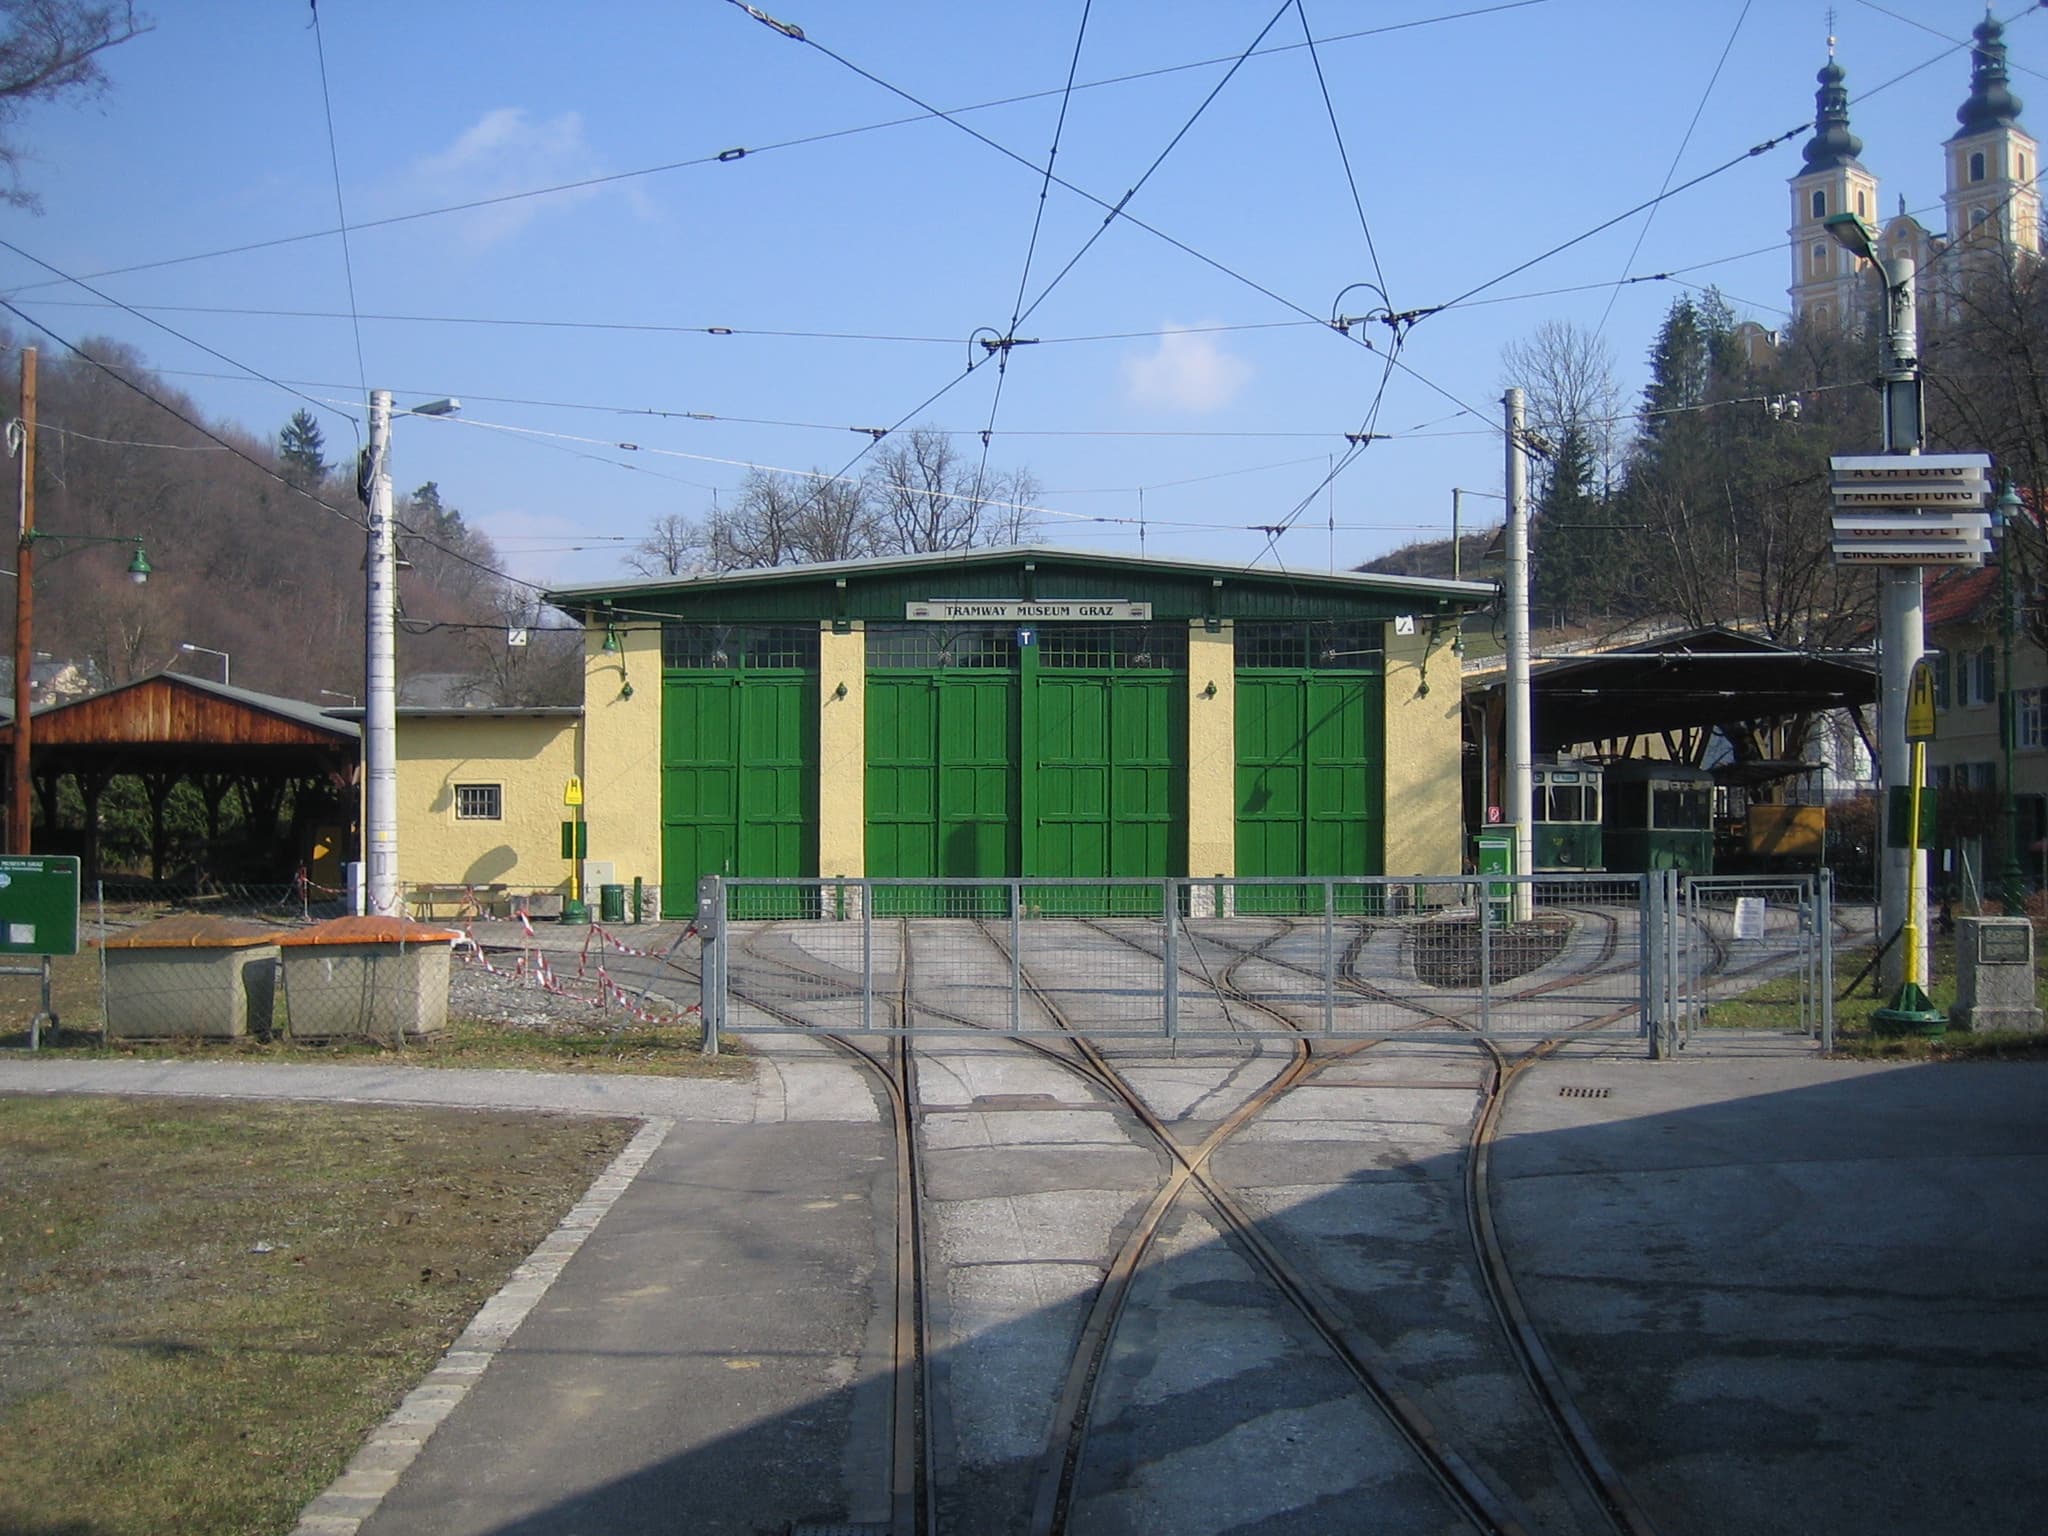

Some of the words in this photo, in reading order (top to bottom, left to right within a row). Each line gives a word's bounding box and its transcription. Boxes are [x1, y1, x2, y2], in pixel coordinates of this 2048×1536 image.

[946, 606, 1007, 616] TRAMWAY
[1016, 606, 1070, 616] MUSEUM
[1079, 606, 1114, 616] GRAZ
[1021, 631, 1031, 645] T
